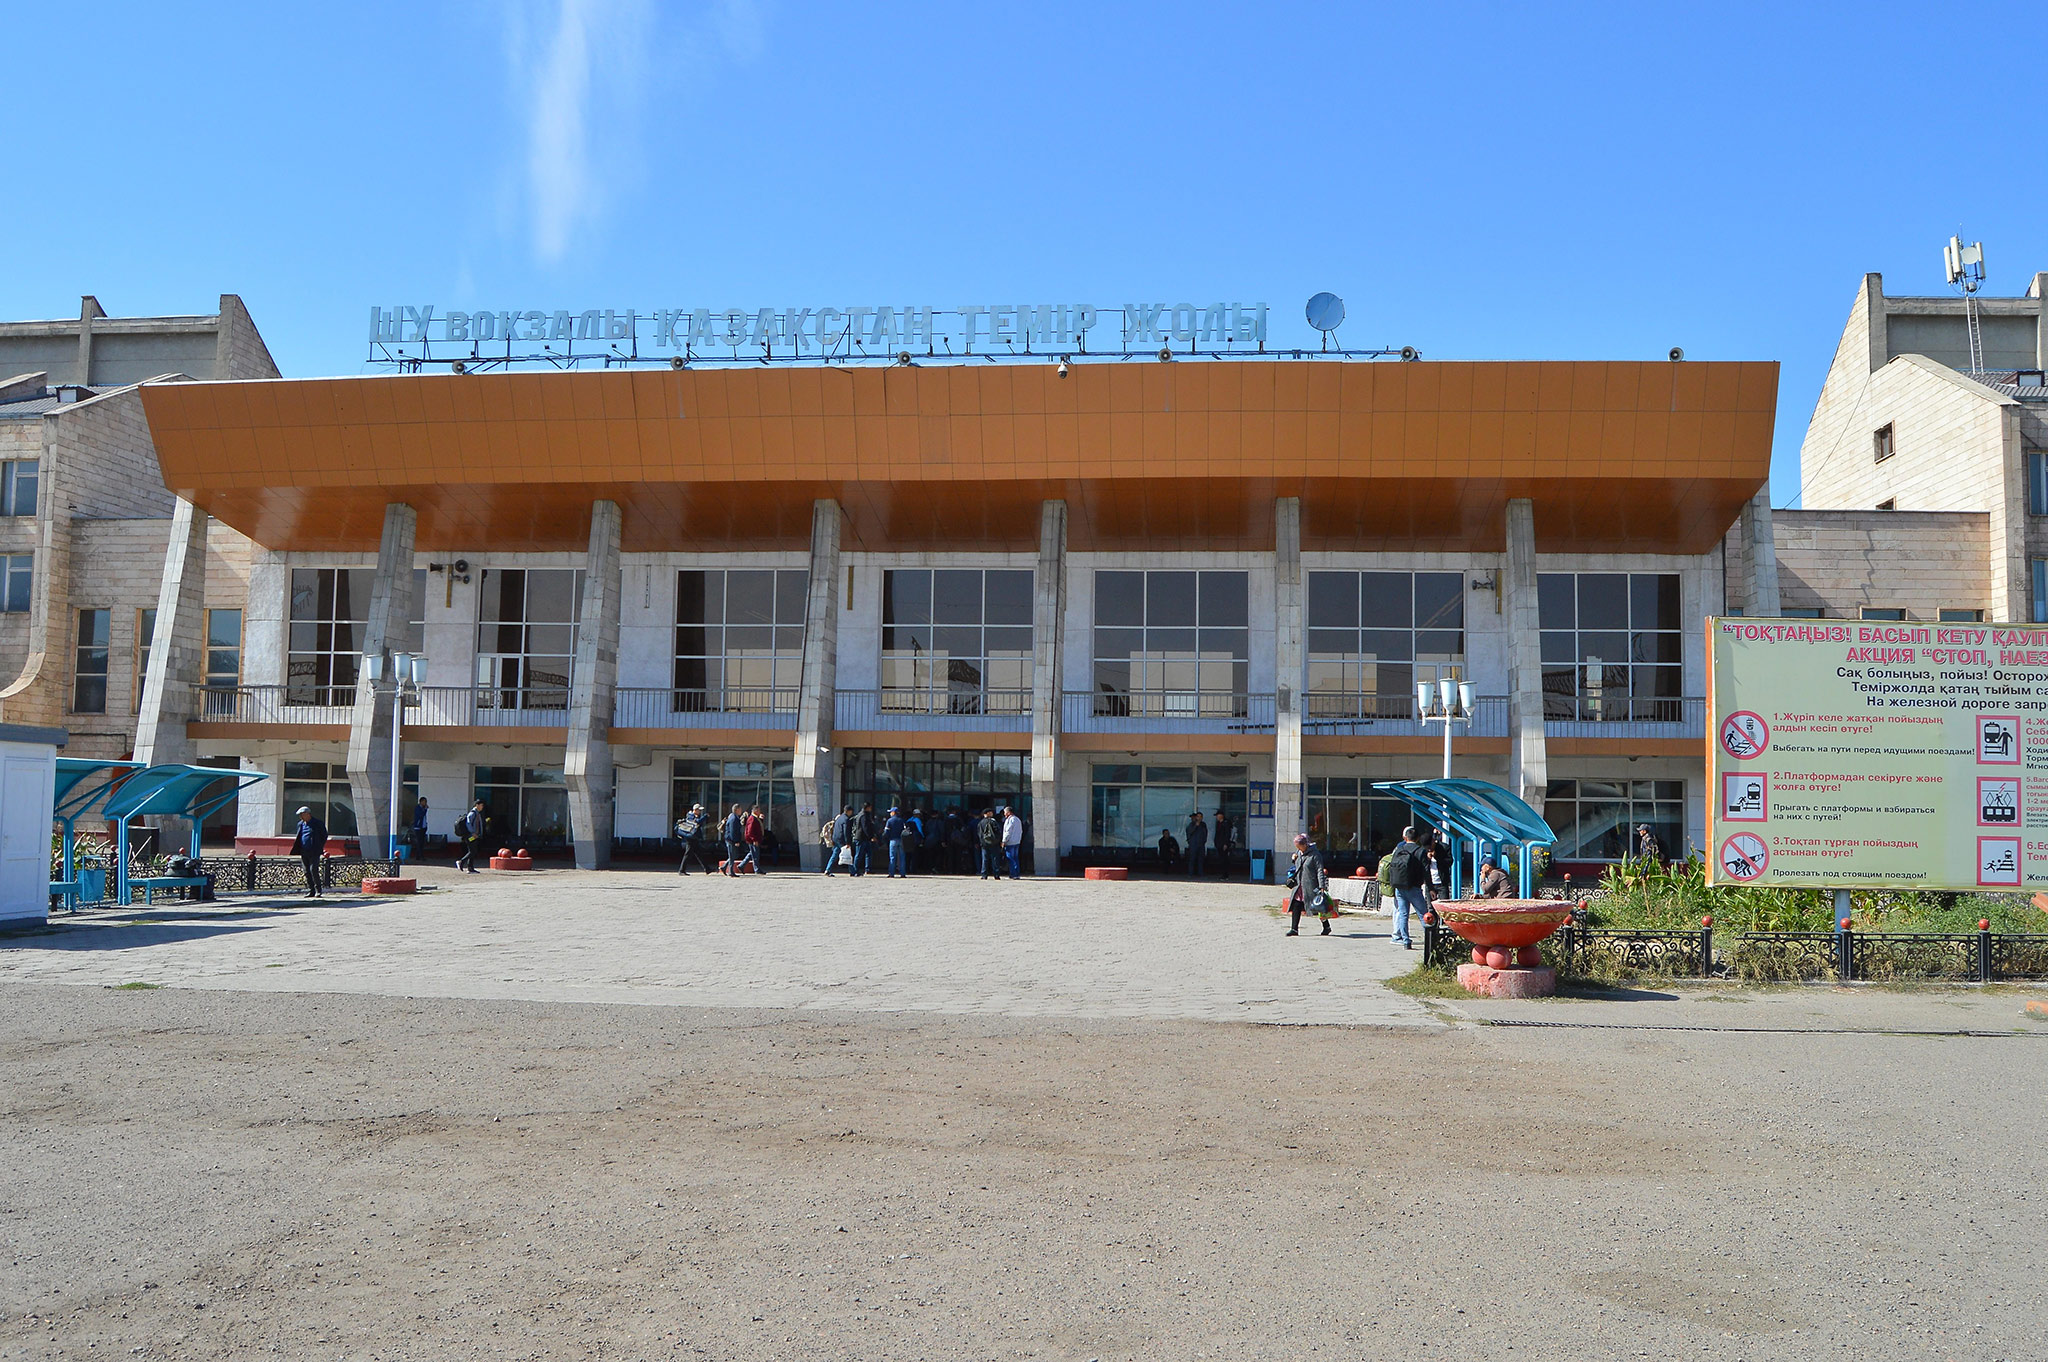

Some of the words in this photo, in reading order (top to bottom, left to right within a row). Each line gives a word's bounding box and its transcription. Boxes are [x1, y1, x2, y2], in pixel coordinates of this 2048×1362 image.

[369, 305, 434, 343] ШУ
[446, 309, 636, 341] ВОКЗАЛЫ
[656, 306, 932, 350] ҚАЗАҚСТАН
[957, 304, 1097, 344] ТЕМІР
[1123, 302, 1267, 342] ЖОЛЫ
[1722, 625, 1852, 644] “ТОҚТАҢЫЗ!
[1859, 627, 1931, 645] БАСЫП
[1936, 629, 1987, 645] КЕТУ
[1846, 647, 1915, 666] АКЦИЯ
[1922, 648, 1993, 668] “СТОП,
[2000, 650, 2048, 667] НАЕЗ
[1836, 667, 1862, 679] Сақ
[1867, 667, 1935, 681] болыңыз,
[1940, 669, 1988, 681] пойыз!
[1852, 682, 1935, 695] Теміржолда
[1940, 685, 1980, 696] қатаң
[1984, 684, 2031, 695] тыйым
[1867, 696, 1884, 706] На
[1889, 697, 1957, 708] железной
[1962, 699, 2010, 710] дороге
[2014, 701, 2047, 712] запр
[1773, 712, 1815, 722] 1.Жүріп
[1846, 715, 1884, 723] жатқан
[1888, 714, 1944, 724] пойыздың
[1810, 724, 1837, 732] кесіп
[1841, 725, 1873, 734] өтуге!
[1772, 744, 1815, 752] Выбегать
[1831, 746, 1851, 754] пути
[1884, 747, 1926, 755] идущими
[1928, 748, 1975, 756] поездами!
[1773, 771, 1865, 782] 2.Платформадан
[1868, 774, 1912, 784] секіруге
[1809, 784, 1841, 793] өтуге!
[1773, 803, 1810, 811] Прыгать
[1821, 805, 1873, 813] платформы
[1884, 805, 1935, 814] взбираться
[1813, 814, 1841, 822] путей!
[1773, 837, 1820, 846] 3.Тоқтап
[1863, 838, 1919, 848] пойыздың
[1821, 849, 1853, 858] өтуге!
[1772, 869, 1820, 877] Пролезать
[1842, 871, 1882, 879] стоящим
[1885, 872, 1927, 880] поездом!
